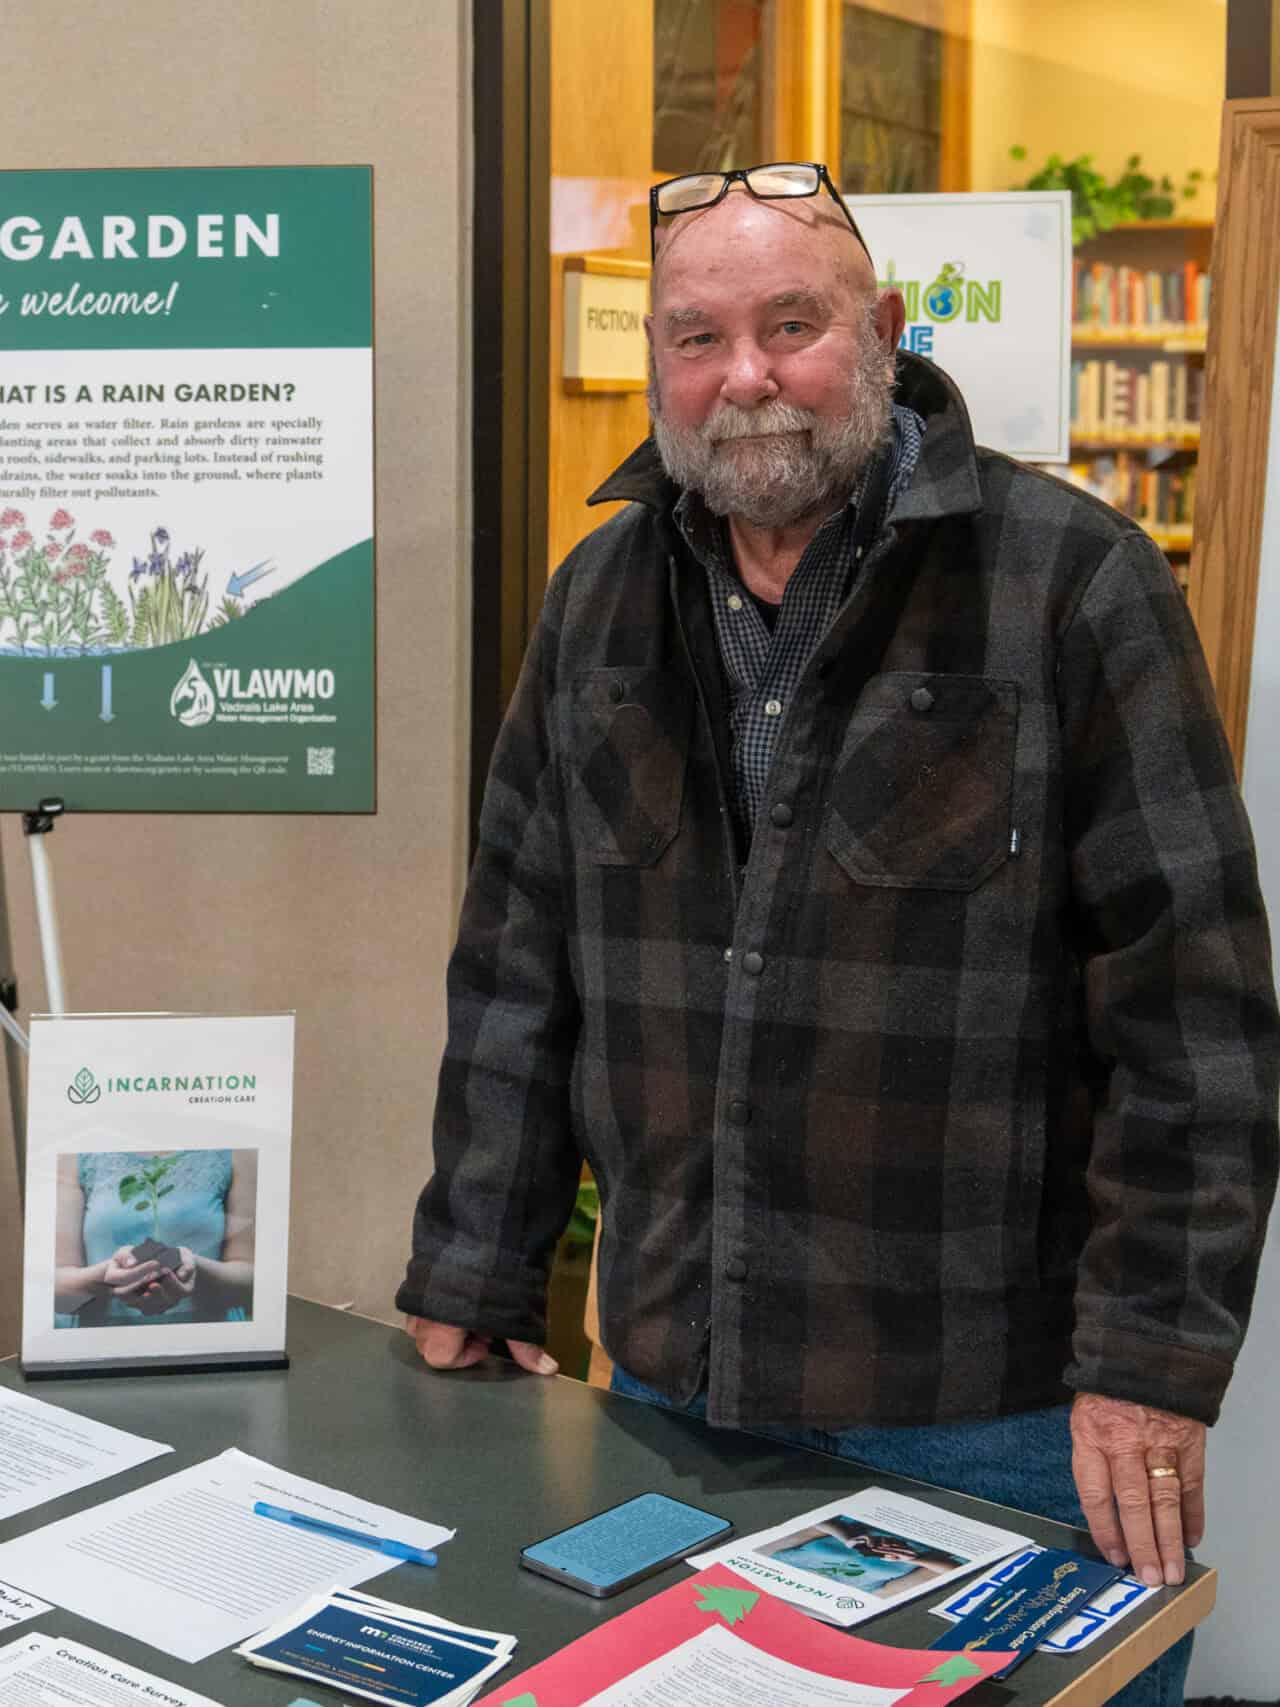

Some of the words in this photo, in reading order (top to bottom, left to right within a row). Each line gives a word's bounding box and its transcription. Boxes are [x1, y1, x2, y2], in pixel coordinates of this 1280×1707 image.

[19, 281, 180, 318] welcome!
[587, 307, 640, 331] FICTION
[45, 385, 66, 403] IS
[76, 385, 93, 403] A
[103, 384, 165, 403] RAIN
[173, 383, 297, 403] GARDEN?
[26, 422, 63, 430] serves
[67, 422, 80, 430] as
[85, 420, 118, 430] water
[123, 418, 155, 430] filter.
[160, 418, 189, 430] Rain
[194, 418, 242, 432] gardens
[246, 420, 266, 429] are
[271, 417, 322, 431] specially
[47, 438, 78, 447] areas
[83, 436, 107, 447] that
[112, 436, 151, 447] collect
[156, 435, 179, 446] and
[184, 434, 225, 446] absorb
[230, 435, 259, 449] dirty
[265, 435, 324, 446] rainwater
[7, 453, 41, 465] roofs,
[44, 452, 106, 464] sidewalks,
[108, 452, 131, 464] and
[134, 452, 182, 466] parking
[184, 452, 210, 464] lots.
[213, 452, 258, 463] Instead
[261, 452, 274, 463] of
[277, 452, 324, 465] rushing
[0, 470, 42, 482] drains,
[45, 470, 65, 481] the
[69, 470, 101, 481] water
[105, 470, 139, 480] soaks
[142, 470, 167, 480] into
[171, 470, 190, 480] the
[193, 469, 242, 483] ground,
[246, 469, 282, 480] where
[285, 468, 324, 482] plants
[39, 486, 69, 498] filter
[71, 487, 92, 499] out
[95, 486, 161, 501] pollutants.
[213, 669, 336, 699] VLAWMO
[263, 702, 289, 713] Lake
[289, 701, 315, 713] Area
[108, 1075, 257, 1092] INCARNATION
[188, 1096, 232, 1104] CREATION
[234, 1095, 257, 1103] CARE
[726, 1558, 835, 1600] INCARNATION
[306, 1628, 347, 1646] ENERGY
[345, 1641, 415, 1667] INFORMATION
[415, 1661, 456, 1680] CENTER
[56, 1649, 109, 1675] Creation
[110, 1672, 141, 1689] Care
[141, 1686, 188, 1707] Survey
